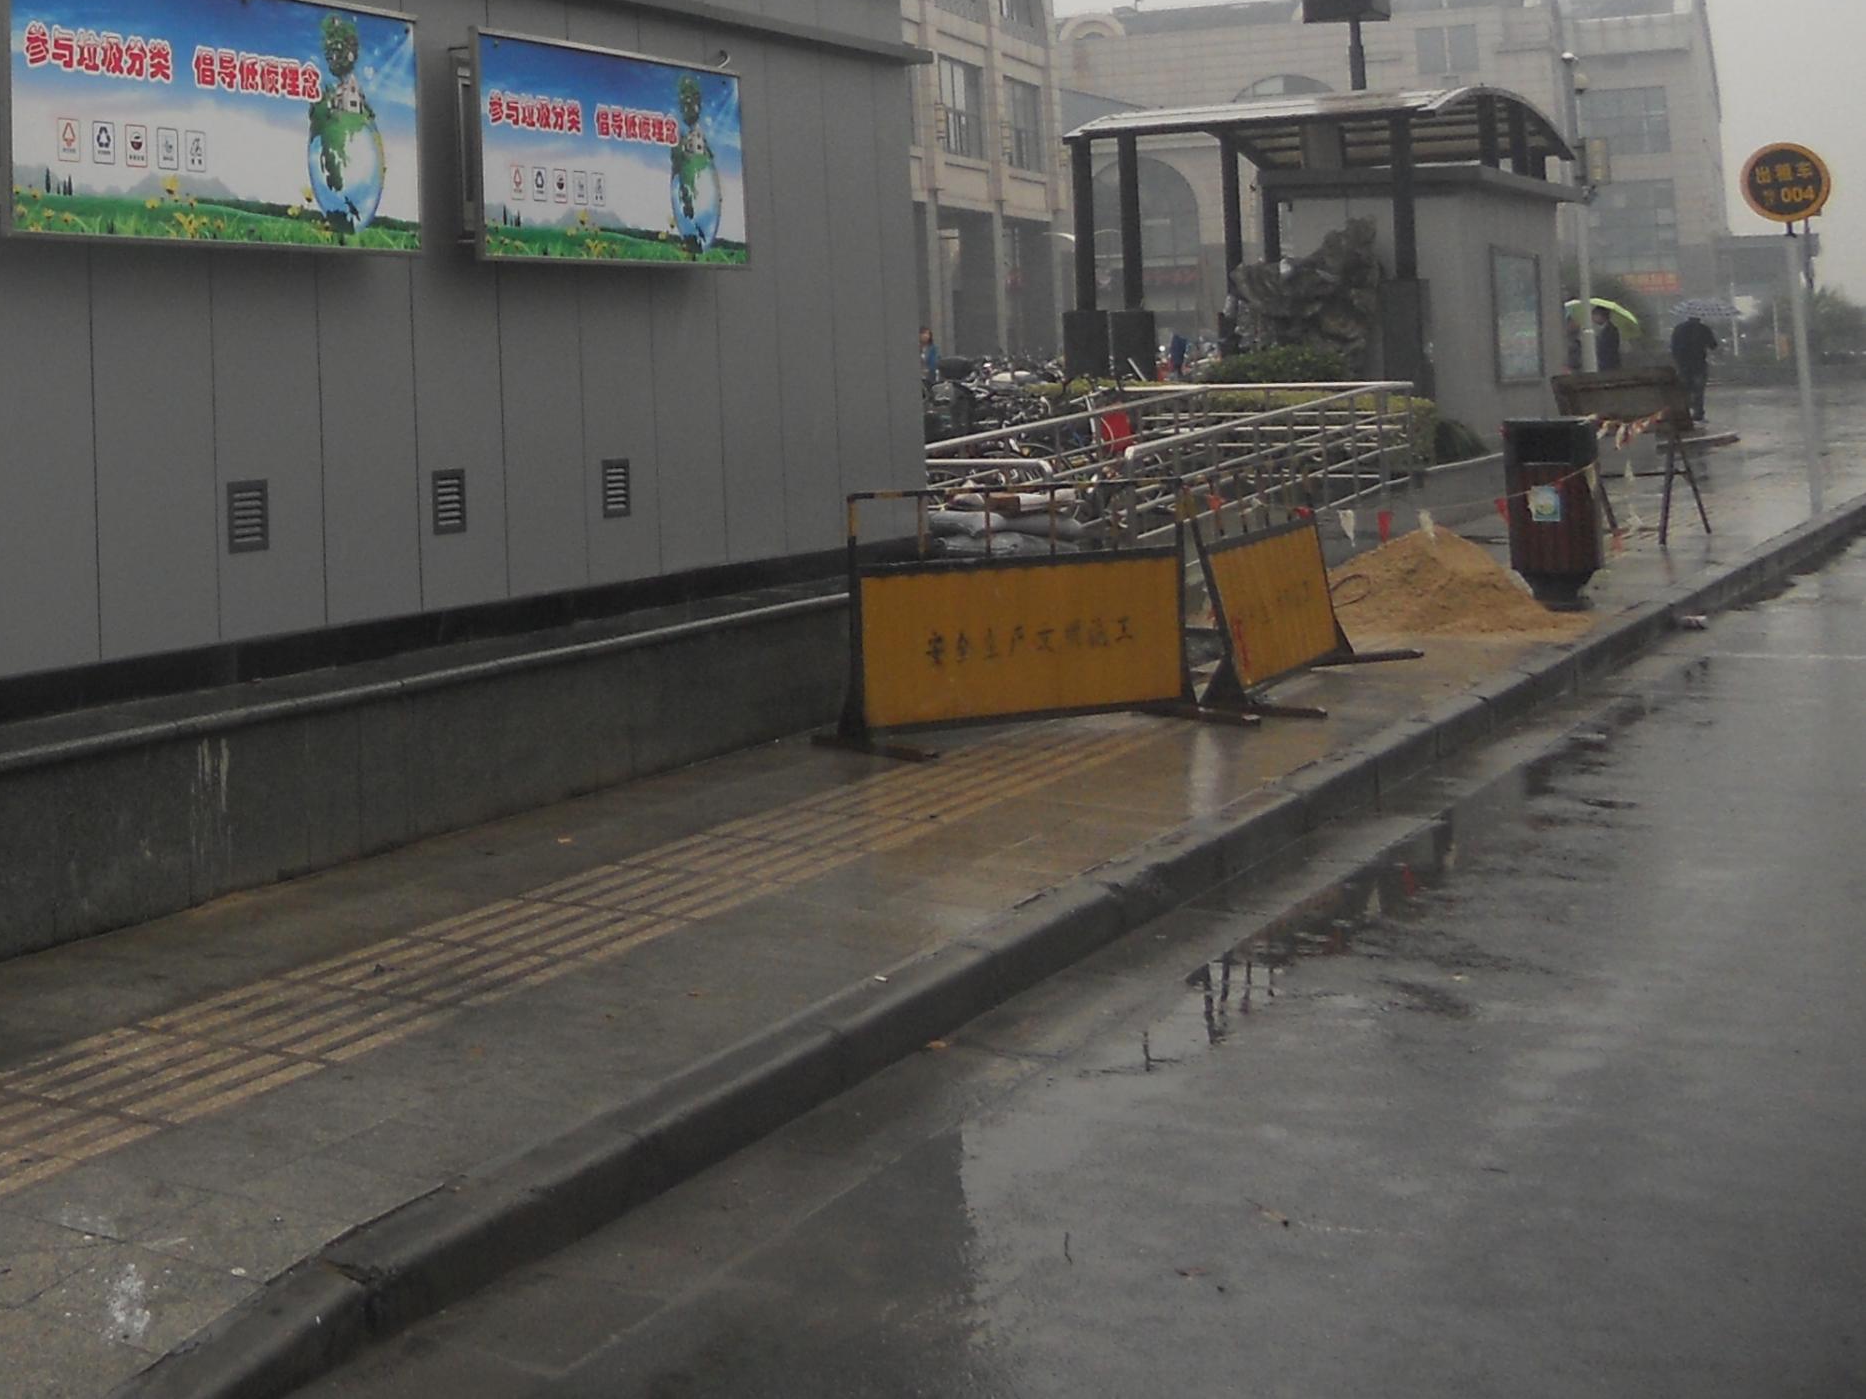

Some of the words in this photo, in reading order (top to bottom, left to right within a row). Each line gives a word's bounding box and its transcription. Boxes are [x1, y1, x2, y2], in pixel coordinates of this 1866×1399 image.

[25, 21, 173, 82] 参与垃圾分类
[193, 45, 322, 102] 倡导低碳理念
[489, 89, 582, 134] 参与垃圾分类
[595, 104, 679, 146] 倡导低碳理念
[1781, 186, 1815, 202] 004
